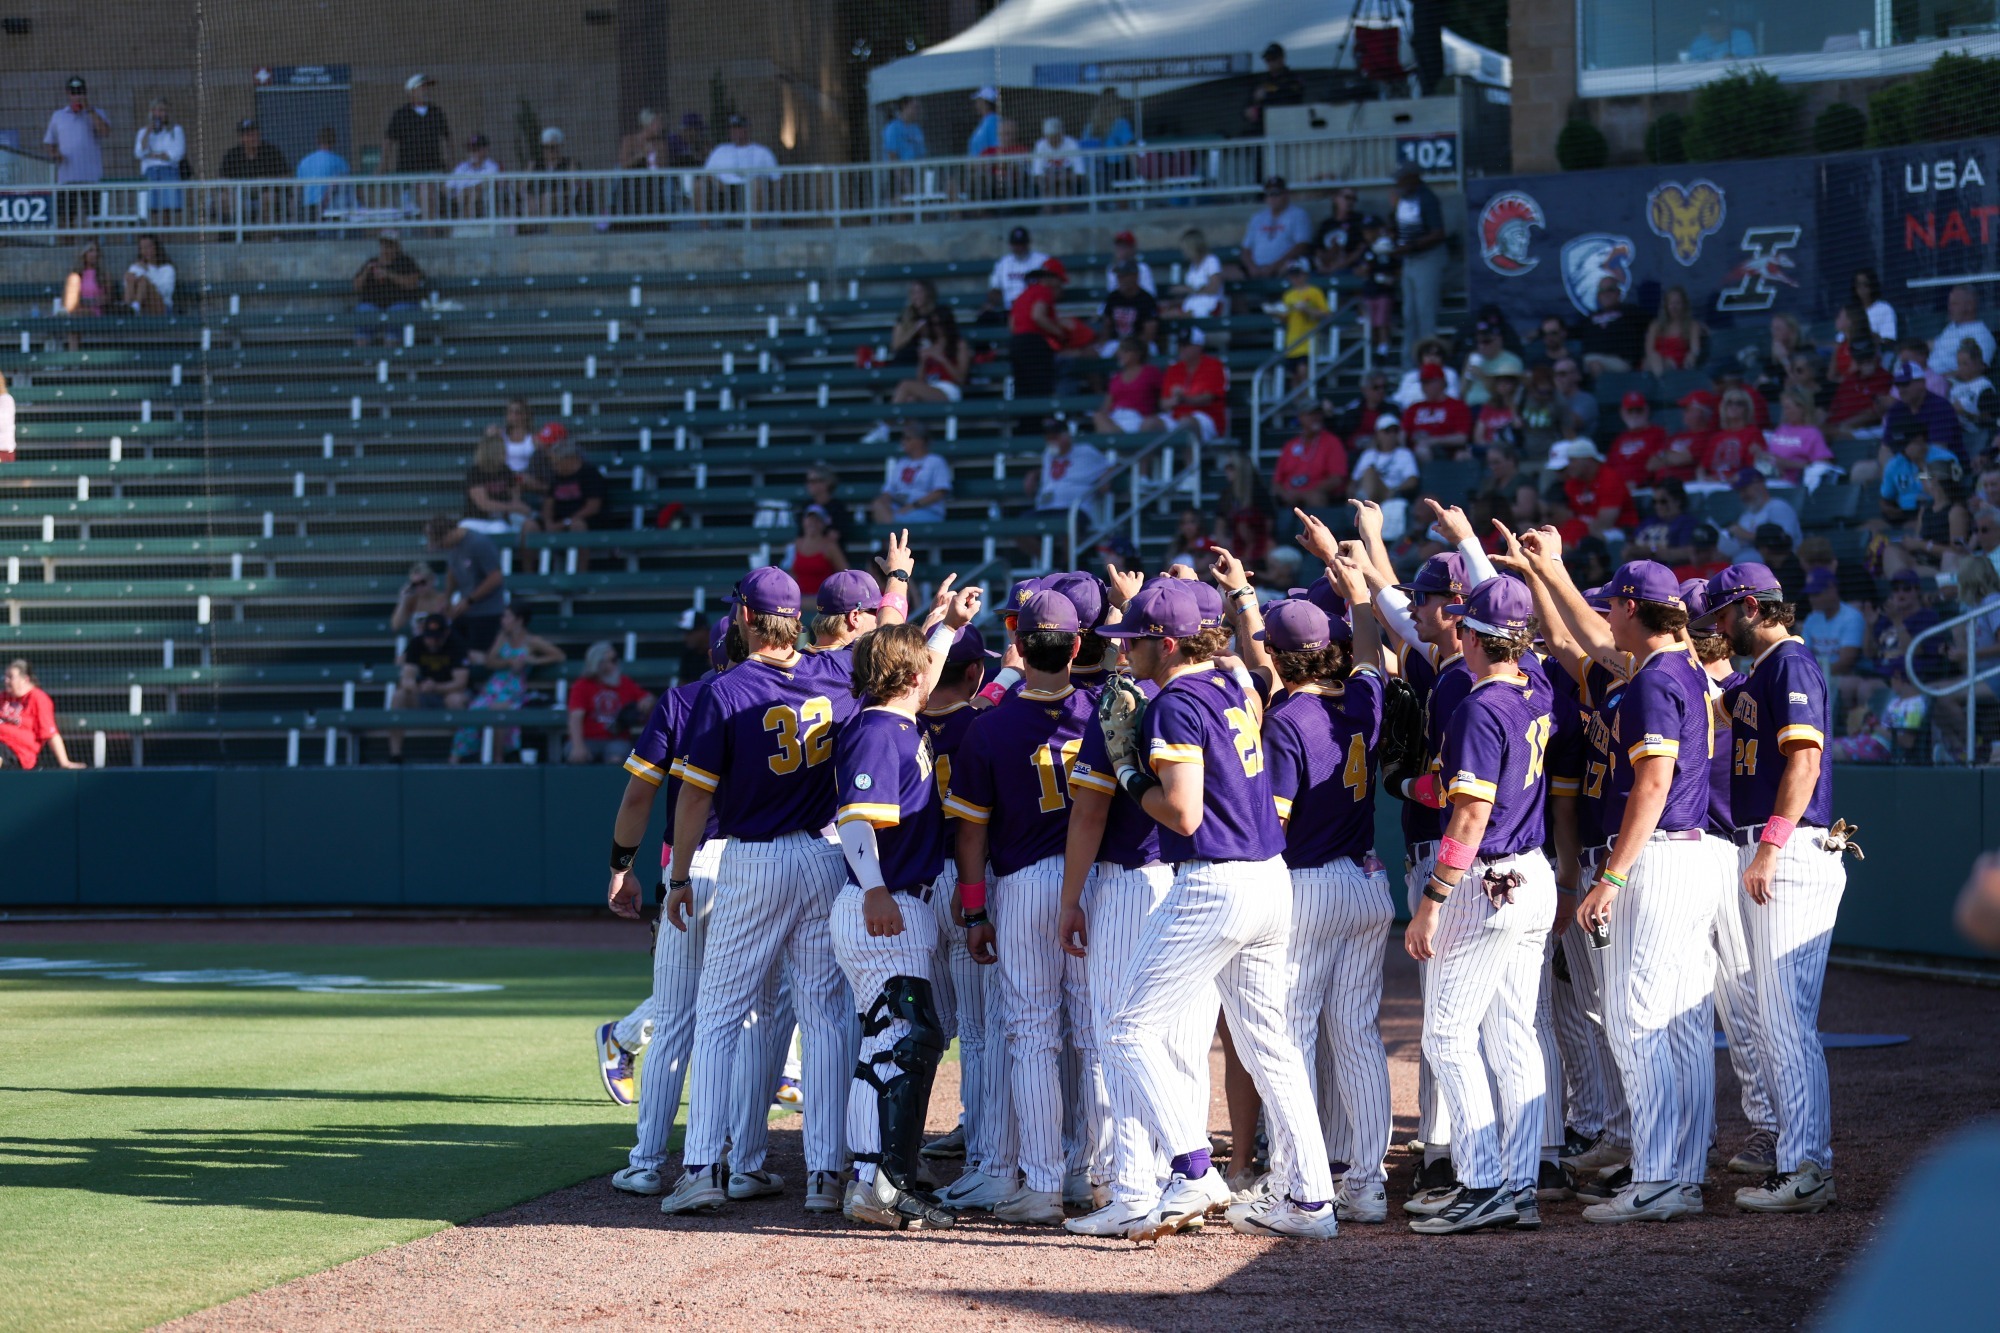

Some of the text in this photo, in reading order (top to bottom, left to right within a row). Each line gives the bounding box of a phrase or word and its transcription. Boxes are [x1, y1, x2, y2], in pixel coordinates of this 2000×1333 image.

[1402, 140, 1453, 169] 102
[1905, 157, 1985, 193] USA
[0, 198, 47, 223] 102
[1905, 206, 1999, 251] NAT
[762, 695, 833, 776] 32
[1343, 732, 1367, 802] 4
[1735, 738, 1758, 775] 24
